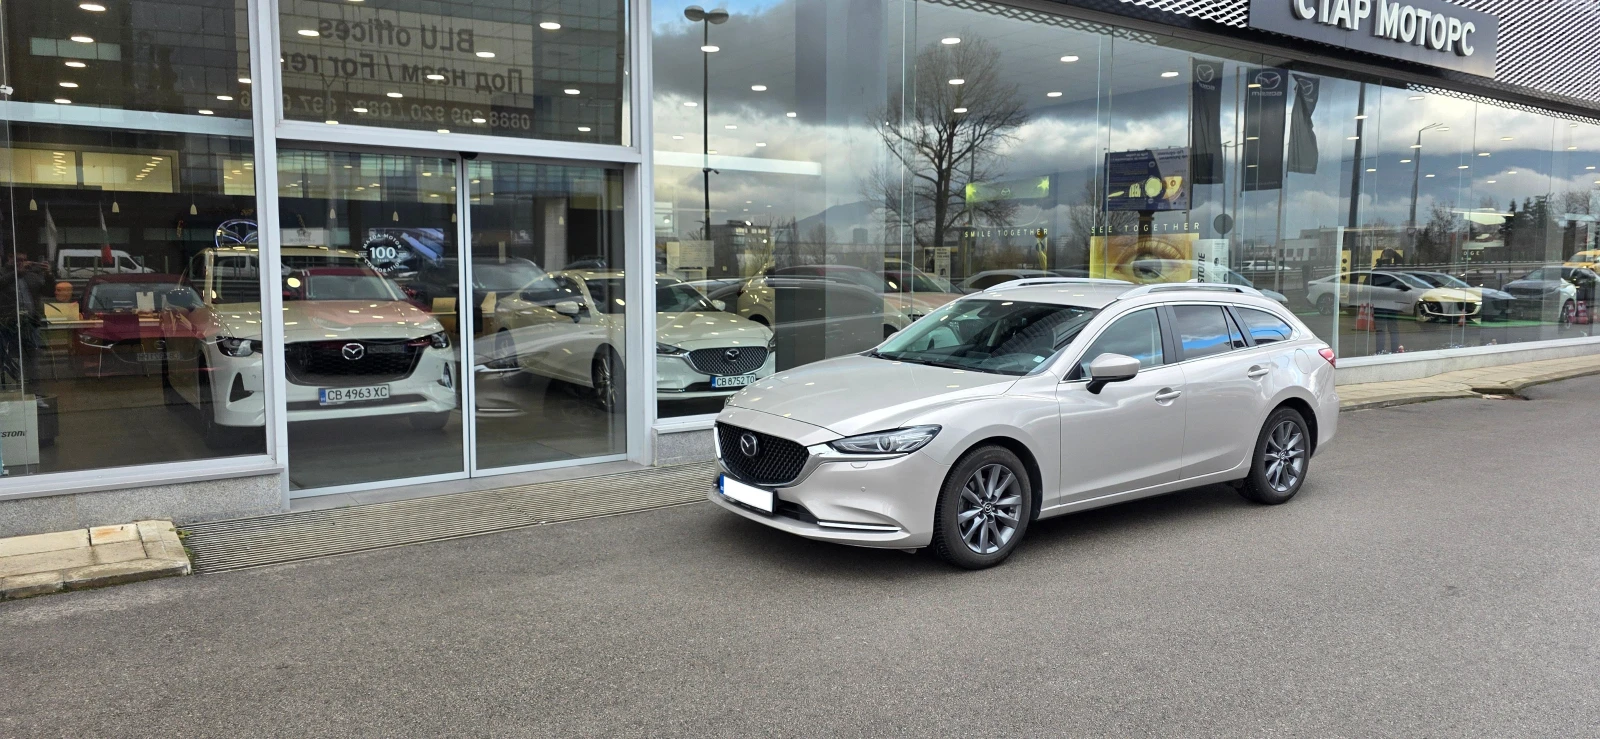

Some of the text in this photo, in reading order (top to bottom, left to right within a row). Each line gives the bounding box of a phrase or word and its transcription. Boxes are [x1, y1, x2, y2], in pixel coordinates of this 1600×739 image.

[1373, 0, 1476, 57] МОТОРС
[964, 228, 1048, 238] SMILE TOGETHER
[1091, 222, 1200, 234] SEE TOGETHER
[362, 233, 402, 249] MAZDA MOTOR
[370, 246, 396, 259] 100
[716, 377, 727, 387] CB
[727, 376, 745, 386] 8752
[327, 387, 388, 401] CB 4963 XC
